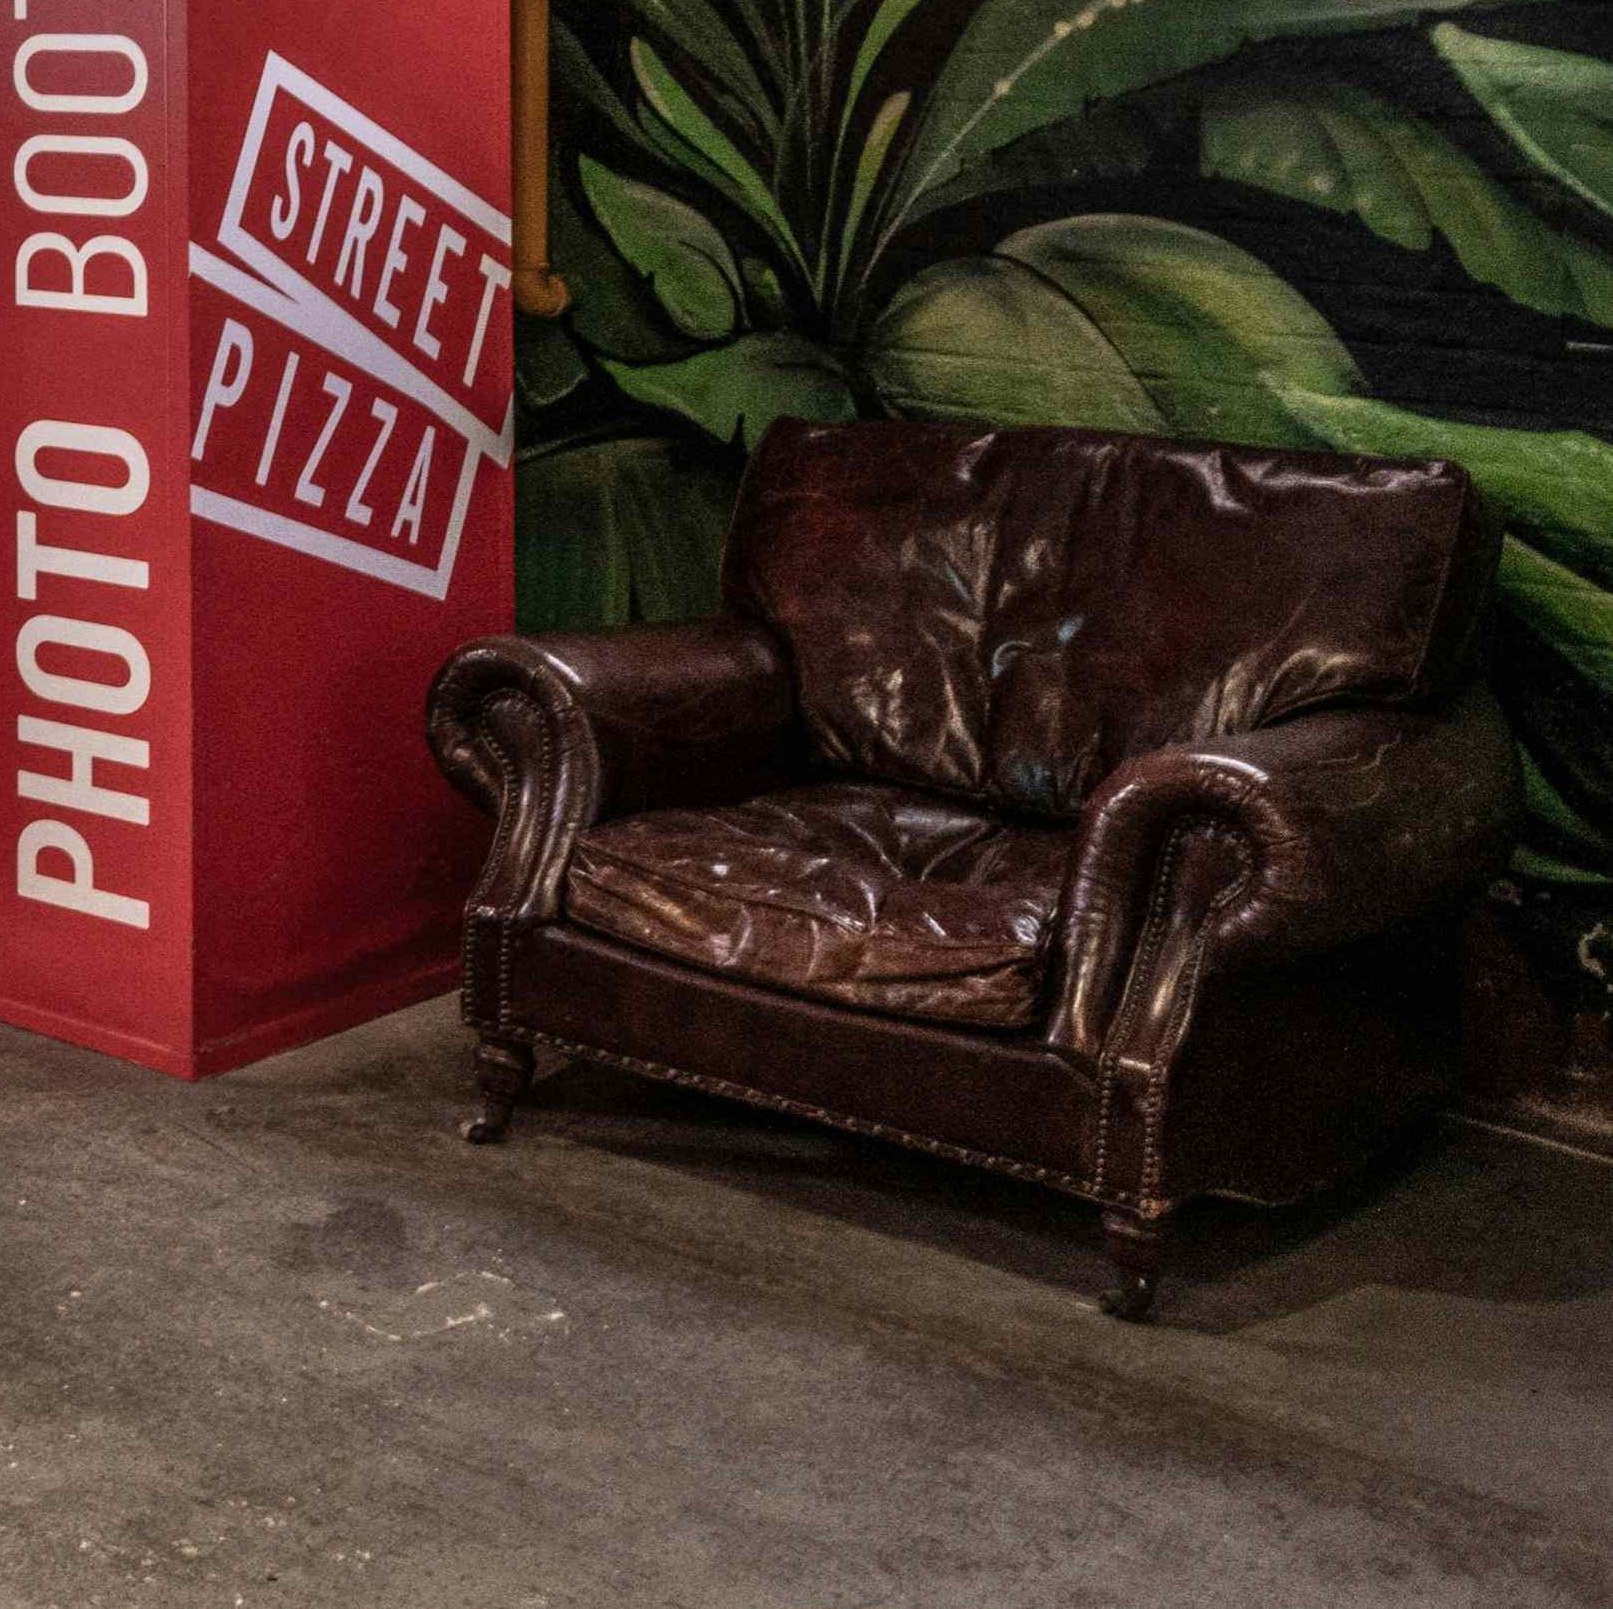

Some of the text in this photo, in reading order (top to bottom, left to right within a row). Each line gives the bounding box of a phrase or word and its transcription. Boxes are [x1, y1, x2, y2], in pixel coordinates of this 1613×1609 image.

[271, 122, 512, 388] STREET
[190, 318, 436, 545] PIZZA
[15, 419, 151, 930] PHOTO
